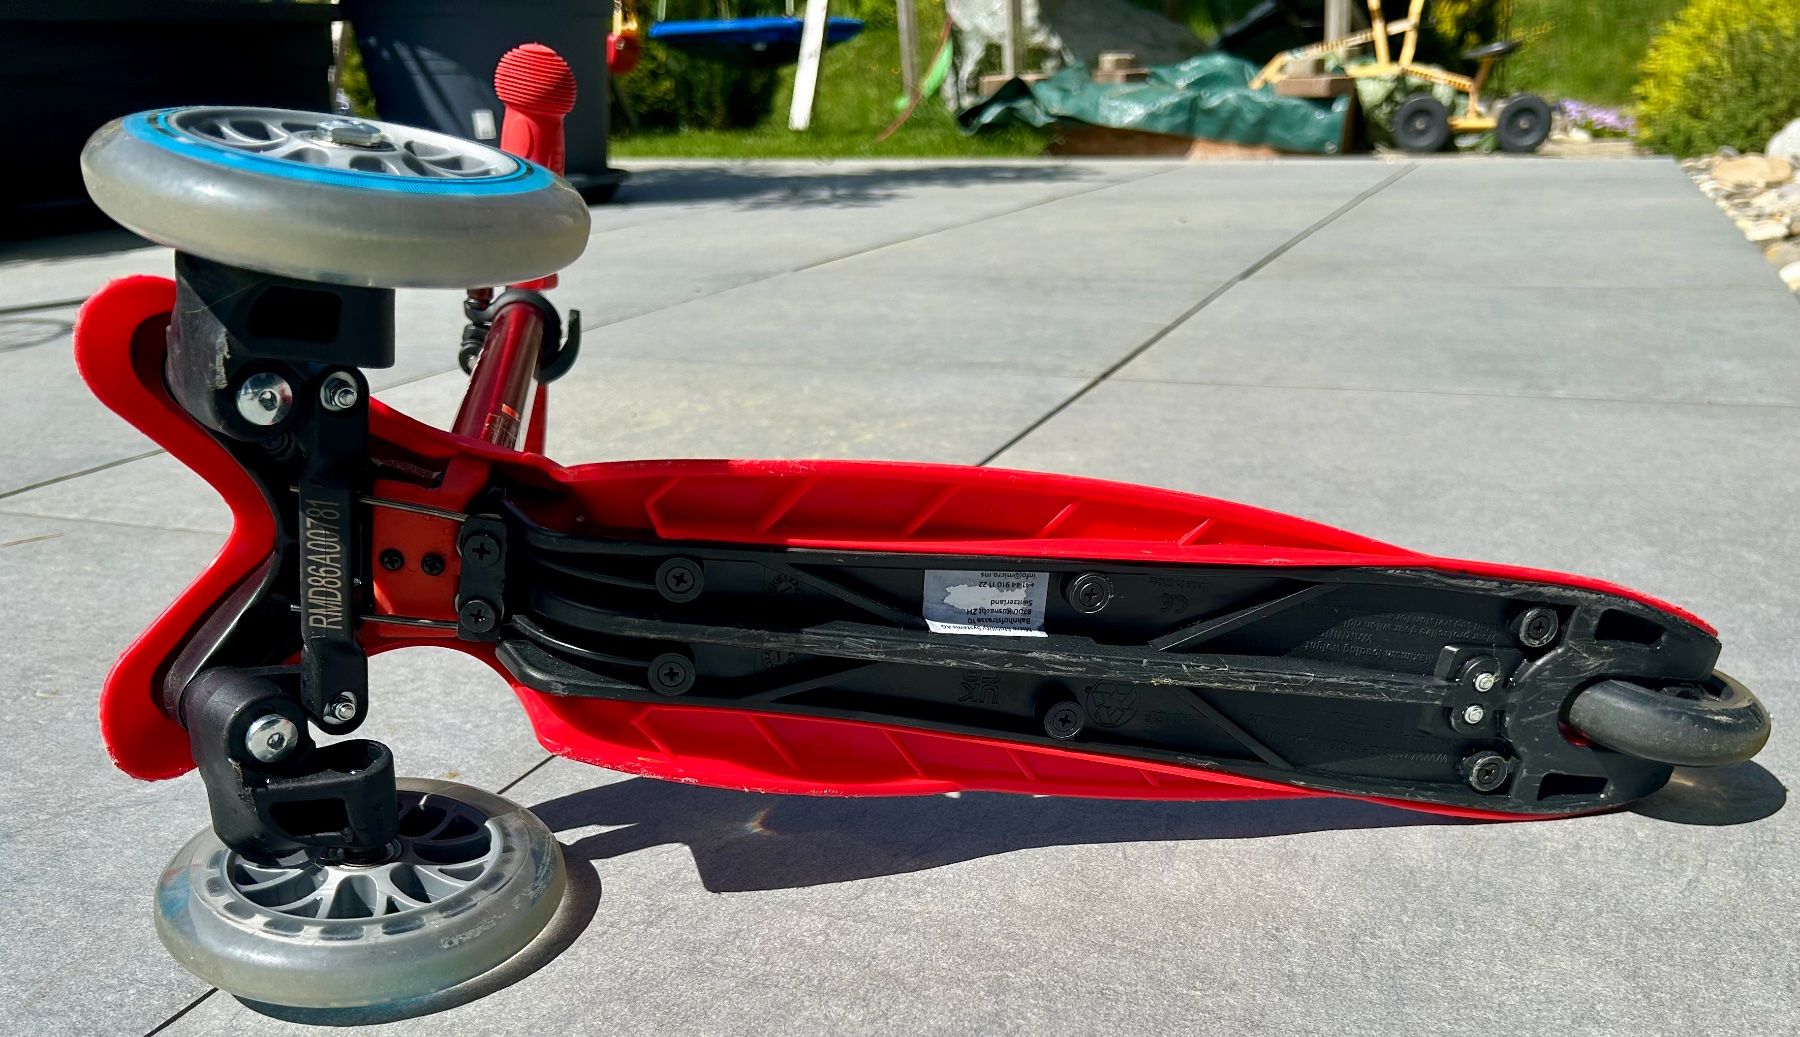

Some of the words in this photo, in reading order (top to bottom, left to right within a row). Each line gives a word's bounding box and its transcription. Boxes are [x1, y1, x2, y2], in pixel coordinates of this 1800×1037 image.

[305, 499, 343, 629] RMD86A00781
[1160, 594, 1188, 614] CE
[958, 682, 1000, 704] UK
